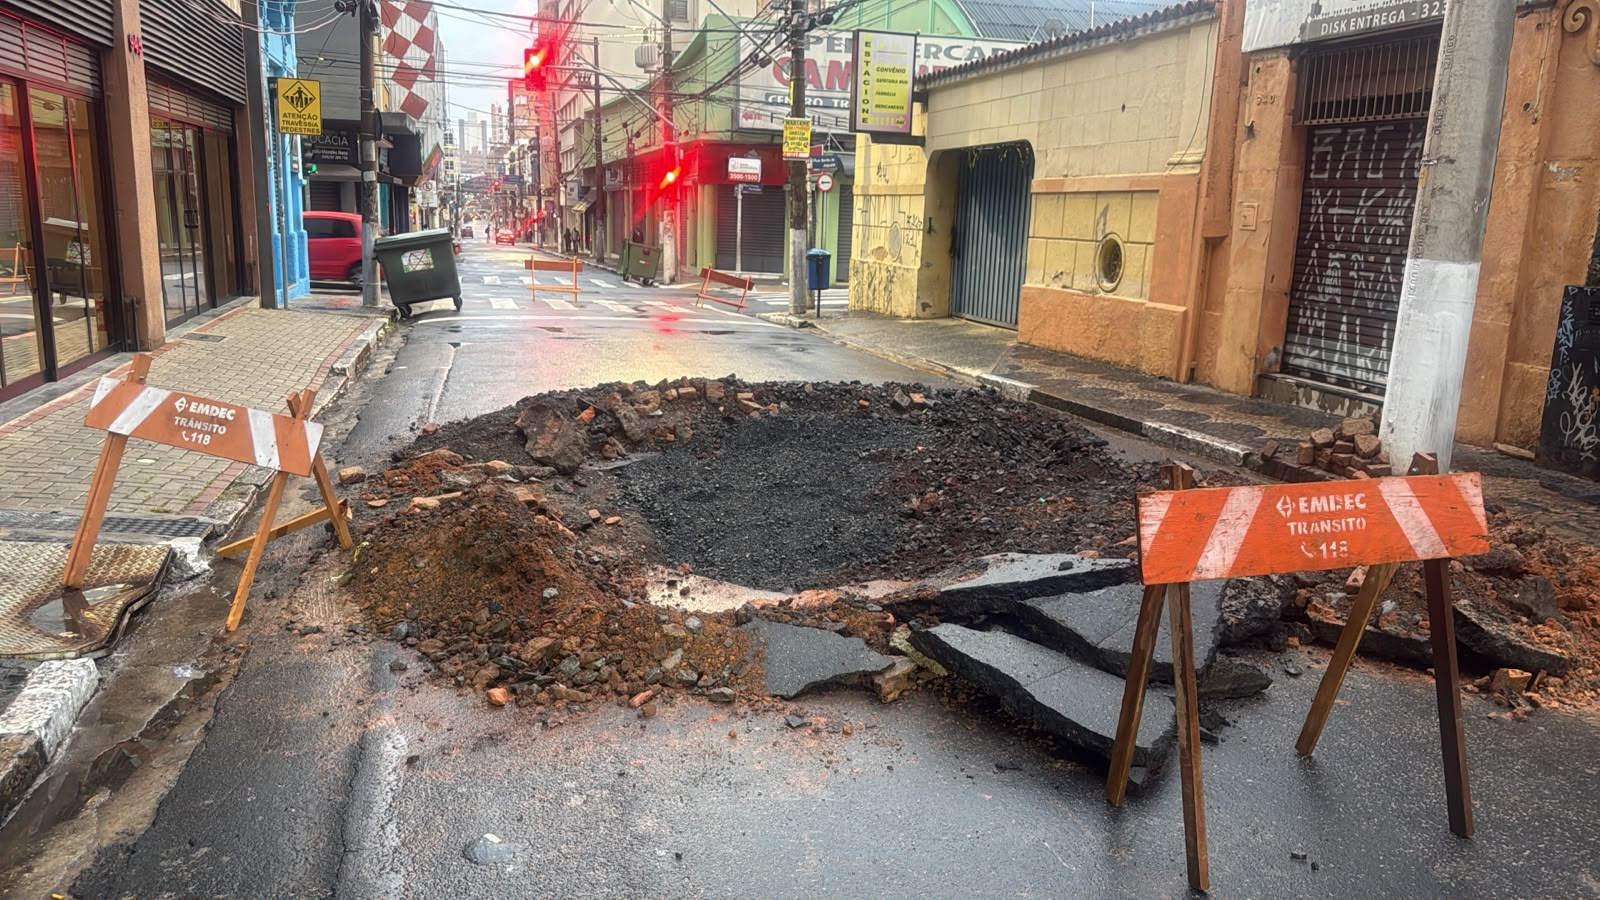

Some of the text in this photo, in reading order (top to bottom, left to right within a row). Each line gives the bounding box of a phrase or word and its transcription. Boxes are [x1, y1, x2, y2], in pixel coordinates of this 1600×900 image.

[1321, 19, 1348, 36] DISK
[1349, 9, 1406, 31] ENTREGA
[282, 112, 318, 121] ATENÇÃO
[281, 119, 319, 128] TRAVESSIA
[281, 126, 320, 134] PEDESTRES
[189, 401, 236, 421] EMDEC
[191, 432, 211, 445] 118
[1298, 493, 1366, 514] EMDEC
